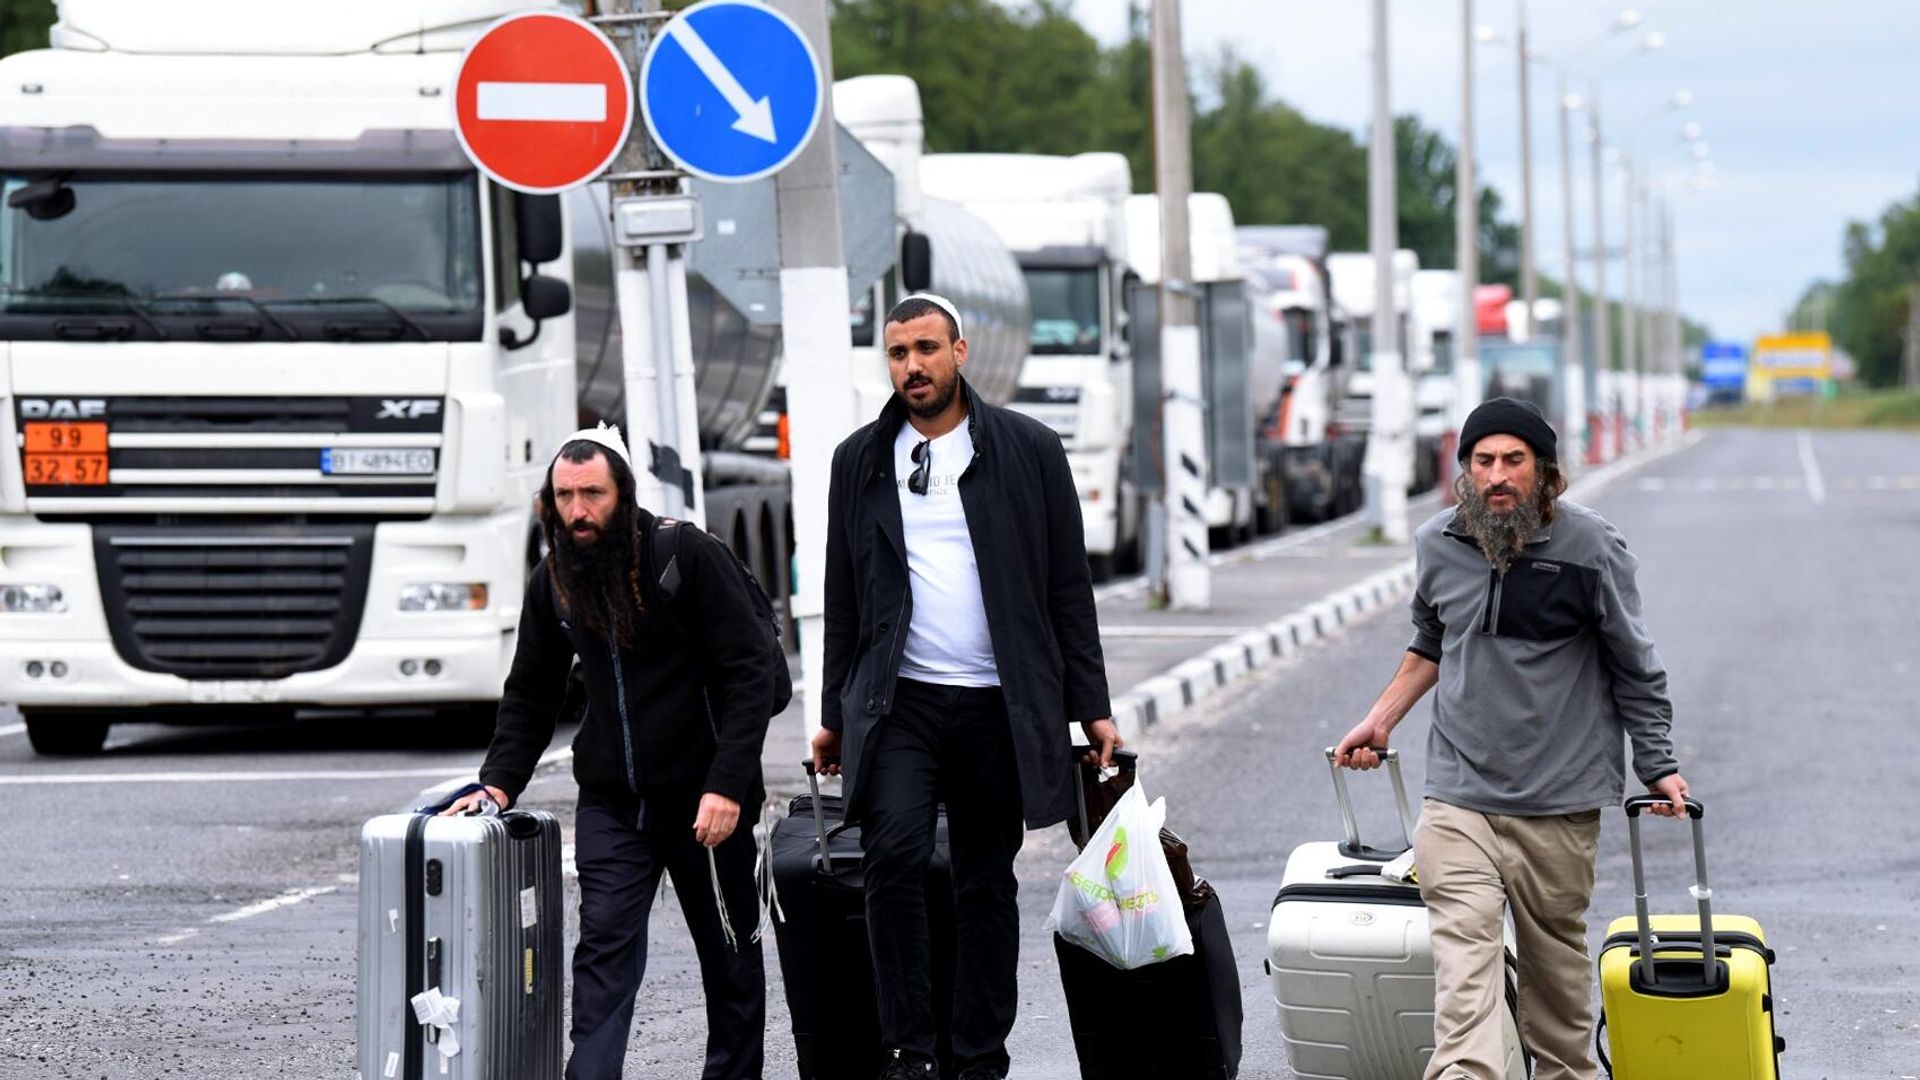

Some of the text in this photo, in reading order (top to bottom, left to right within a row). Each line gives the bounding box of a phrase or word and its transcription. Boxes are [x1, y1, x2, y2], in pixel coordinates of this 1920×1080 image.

[21, 399, 106, 418] DAF
[376, 399, 441, 418] XF
[50, 427, 82, 448] 99
